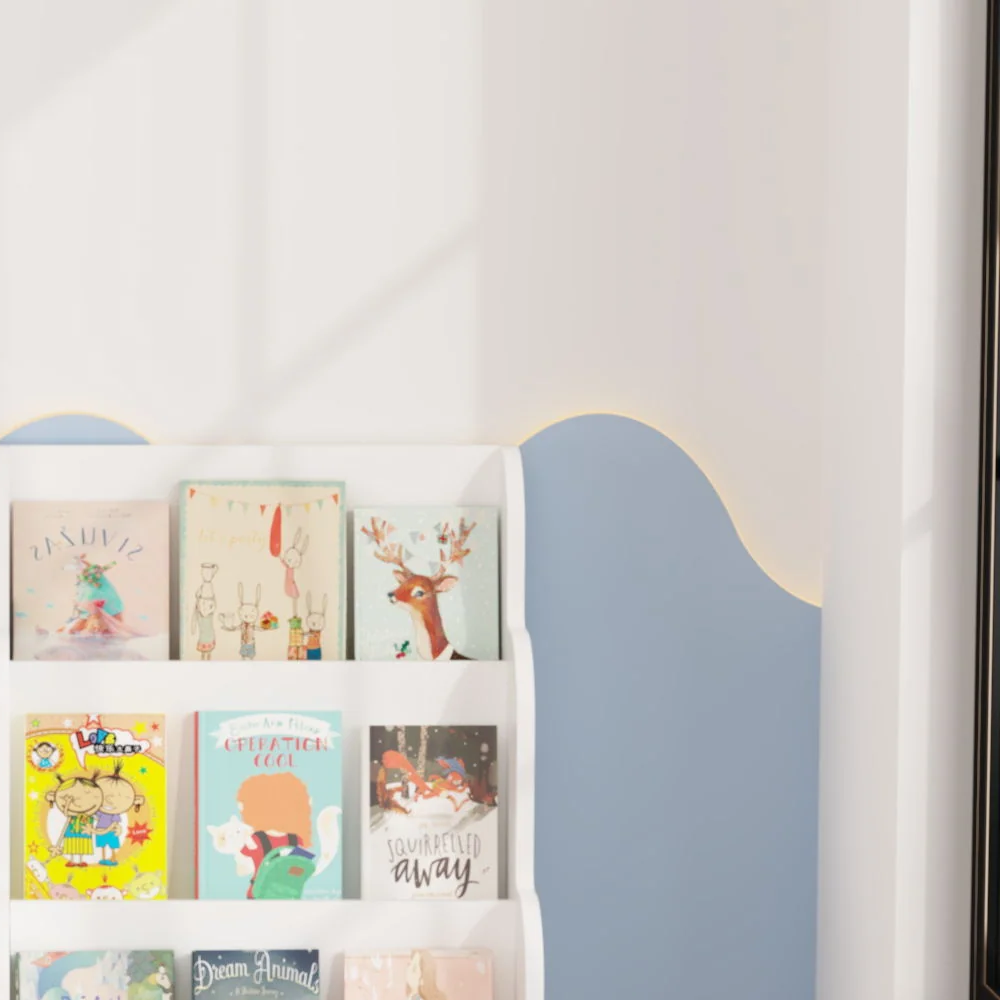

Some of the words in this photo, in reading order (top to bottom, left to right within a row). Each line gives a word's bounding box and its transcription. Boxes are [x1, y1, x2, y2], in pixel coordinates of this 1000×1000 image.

[253, 752, 297, 768] COOL
[386, 832, 482, 863] SQUIRRELLED
[390, 856, 480, 899] away
[193, 955, 250, 996] Dream
[252, 950, 320, 995] Animals
